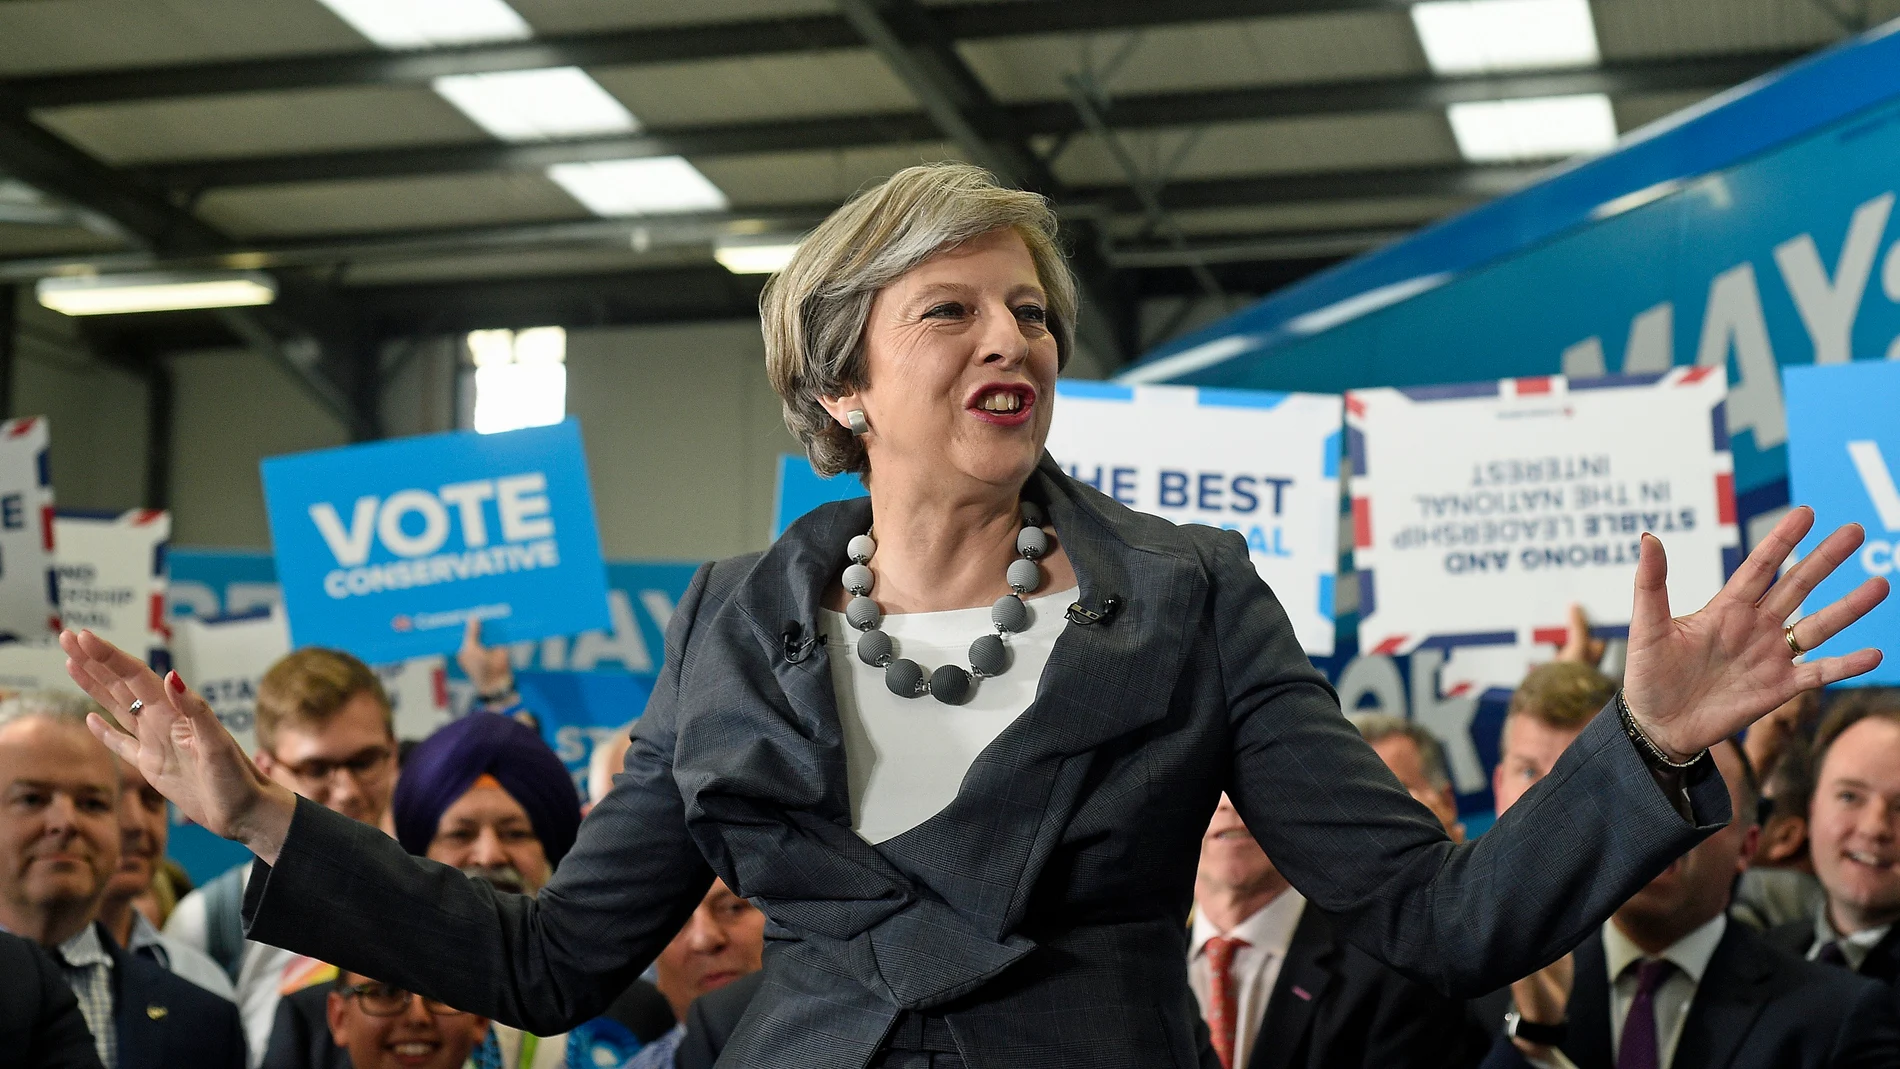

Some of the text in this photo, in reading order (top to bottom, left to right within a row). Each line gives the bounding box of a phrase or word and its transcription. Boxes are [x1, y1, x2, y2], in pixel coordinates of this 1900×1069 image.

[1159, 470, 1294, 515] BEST
[1472, 453, 1611, 488] INTEREST
[308, 472, 555, 569] VOTE
[1412, 481, 1672, 518] IN THE NATIONAL
[1391, 506, 1698, 552] STABLE LEADERSHIP
[323, 541, 560, 599] CONSERVATIVE
[1444, 550, 1510, 575] AND
